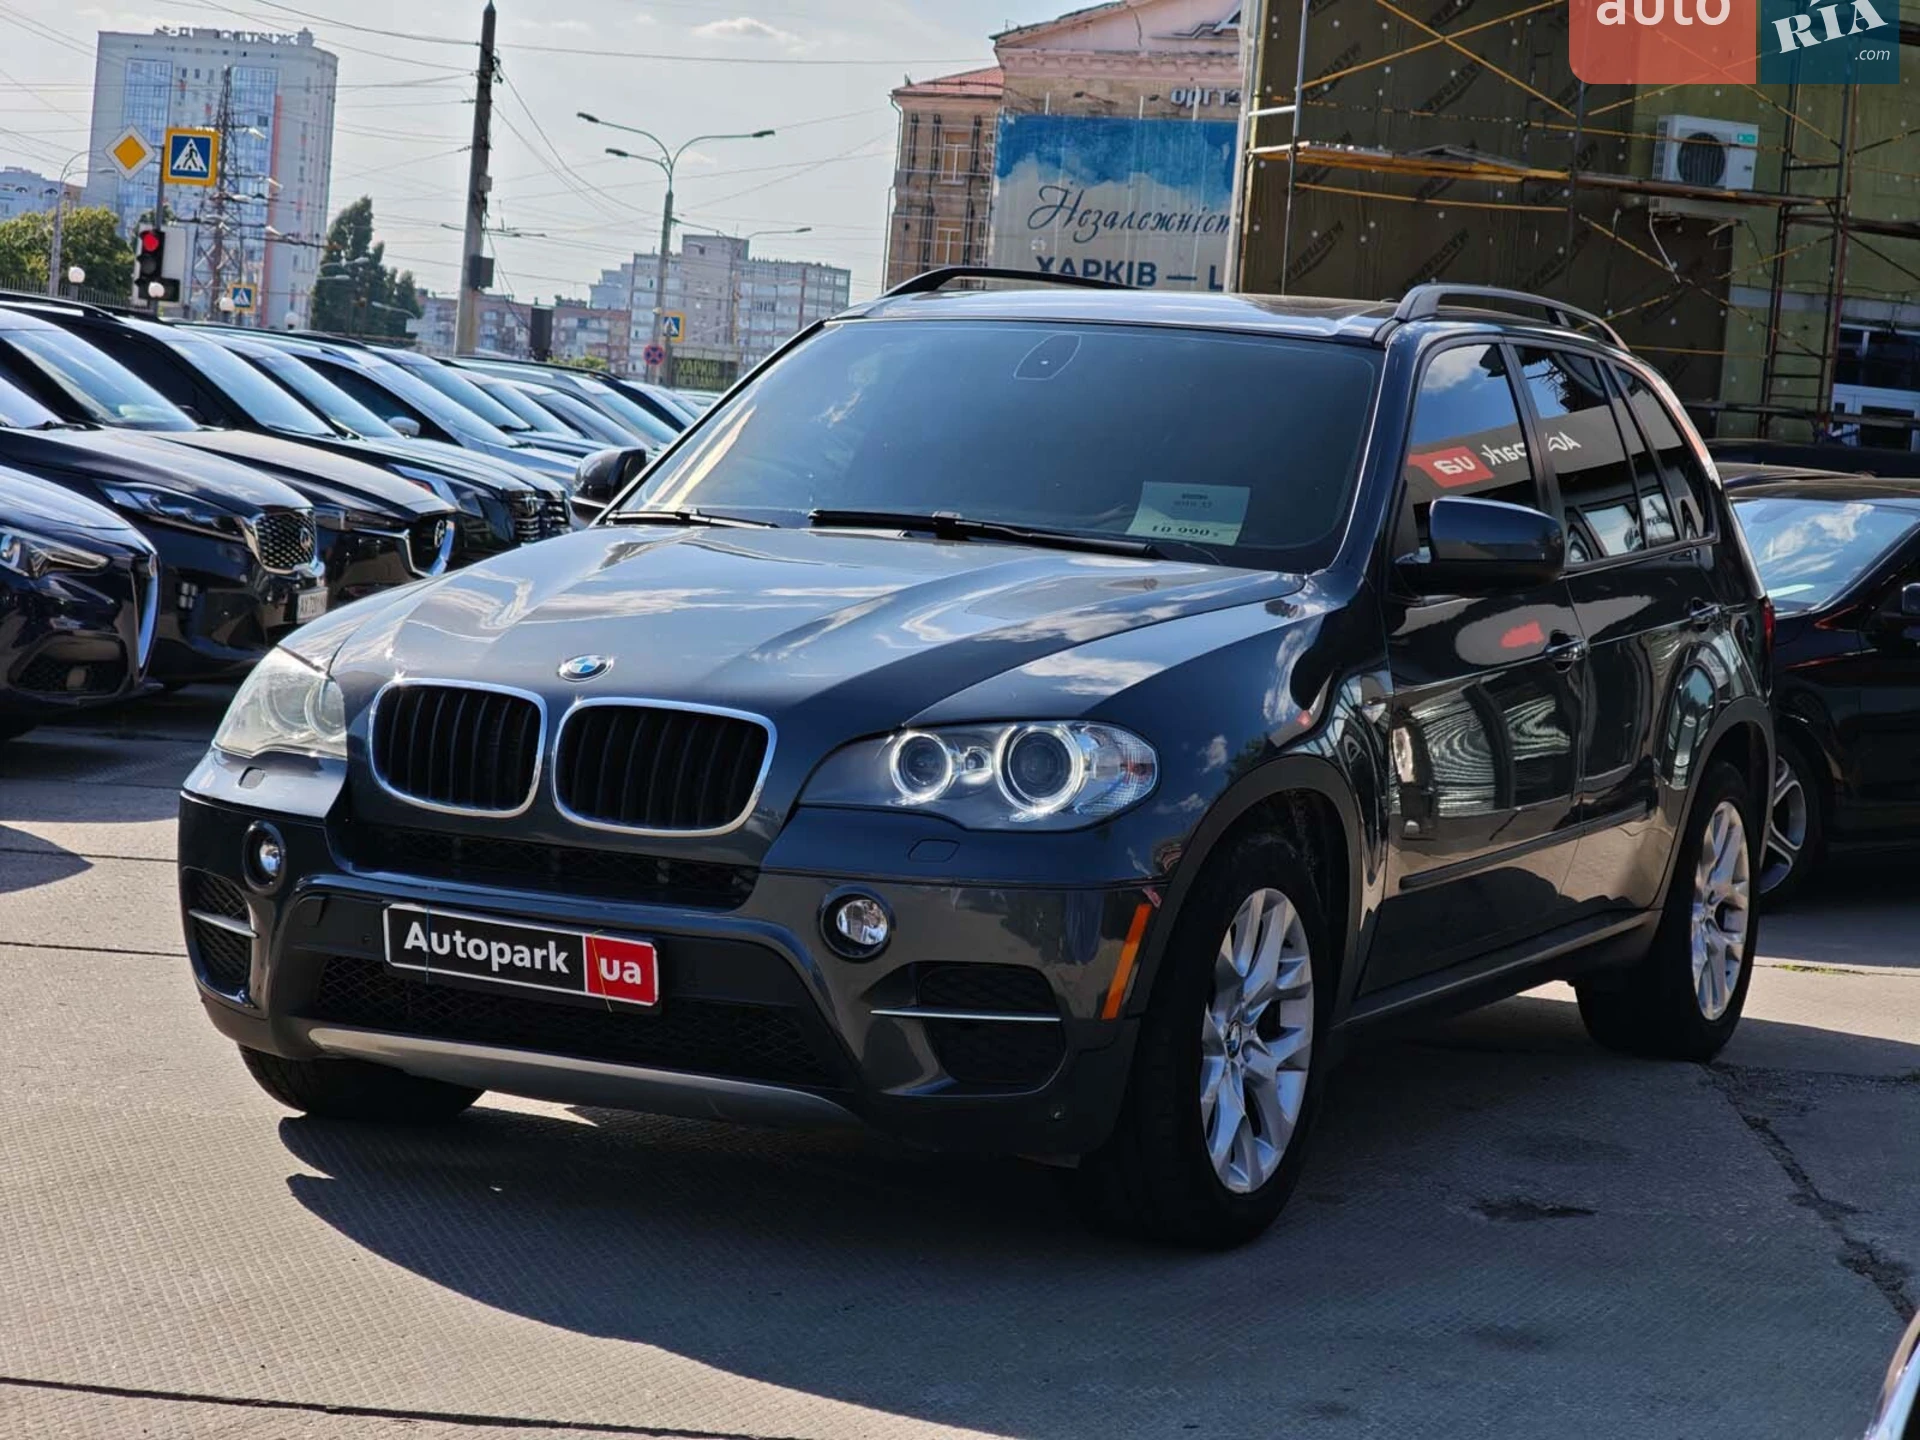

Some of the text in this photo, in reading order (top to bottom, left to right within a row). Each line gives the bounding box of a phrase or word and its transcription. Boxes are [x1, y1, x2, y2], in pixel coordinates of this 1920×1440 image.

[1036, 255, 1158, 287] ХАРКІВ
[403, 920, 642, 985] Autopark ua
